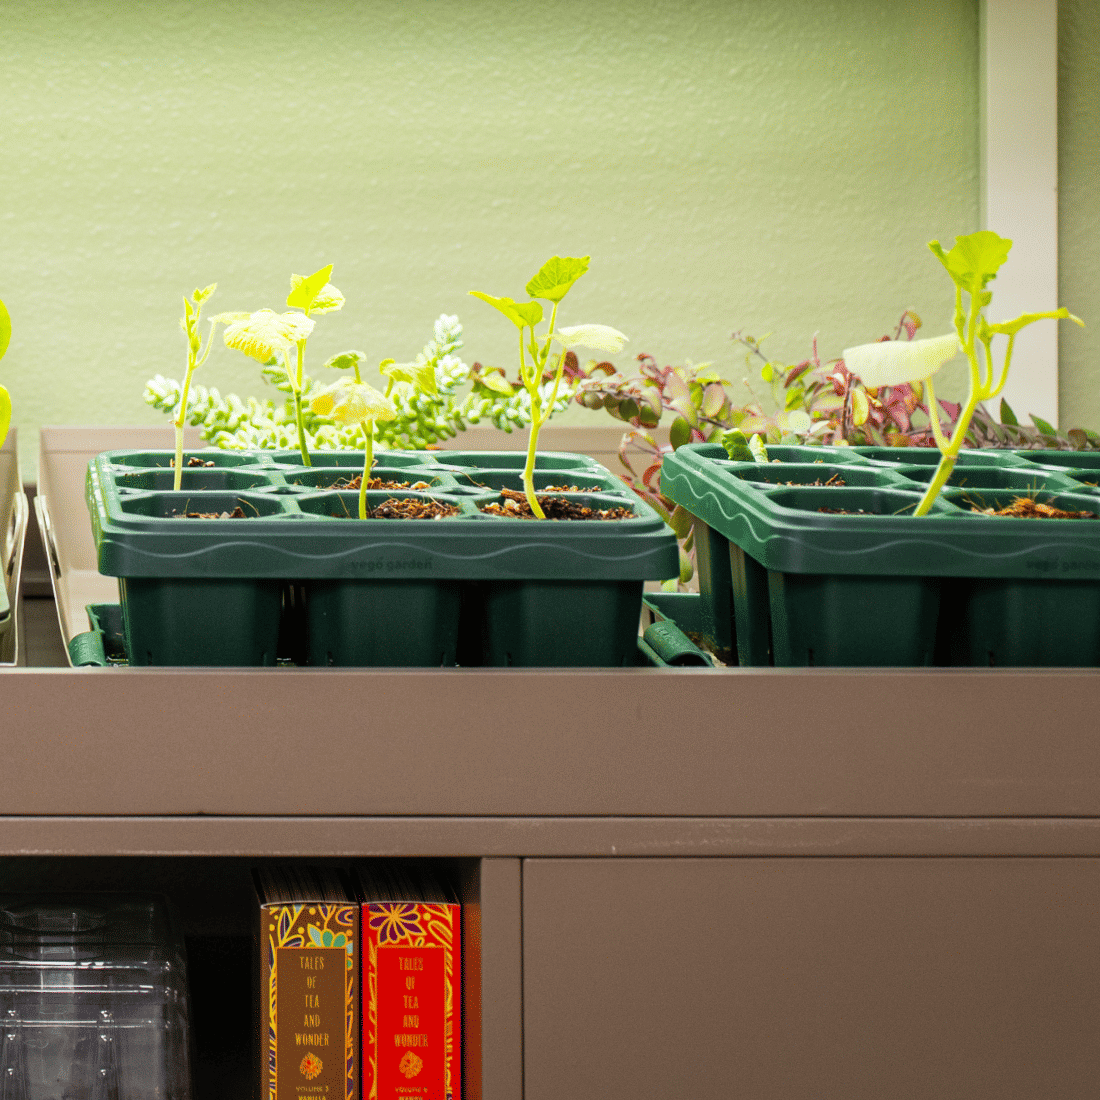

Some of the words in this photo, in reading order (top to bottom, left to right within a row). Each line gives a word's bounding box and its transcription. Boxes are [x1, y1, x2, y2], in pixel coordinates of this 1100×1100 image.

[300, 956, 325, 970] TALES
[398, 956, 424, 971] TALES
[306, 975, 317, 989] OF
[405, 976, 416, 990] OF
[304, 994, 320, 1008] TEA
[403, 994, 420, 1009] TEA
[303, 1014, 321, 1028] AND
[402, 1014, 420, 1029] AND
[295, 1033, 330, 1047] WONDER
[394, 1033, 429, 1048] WONDER
